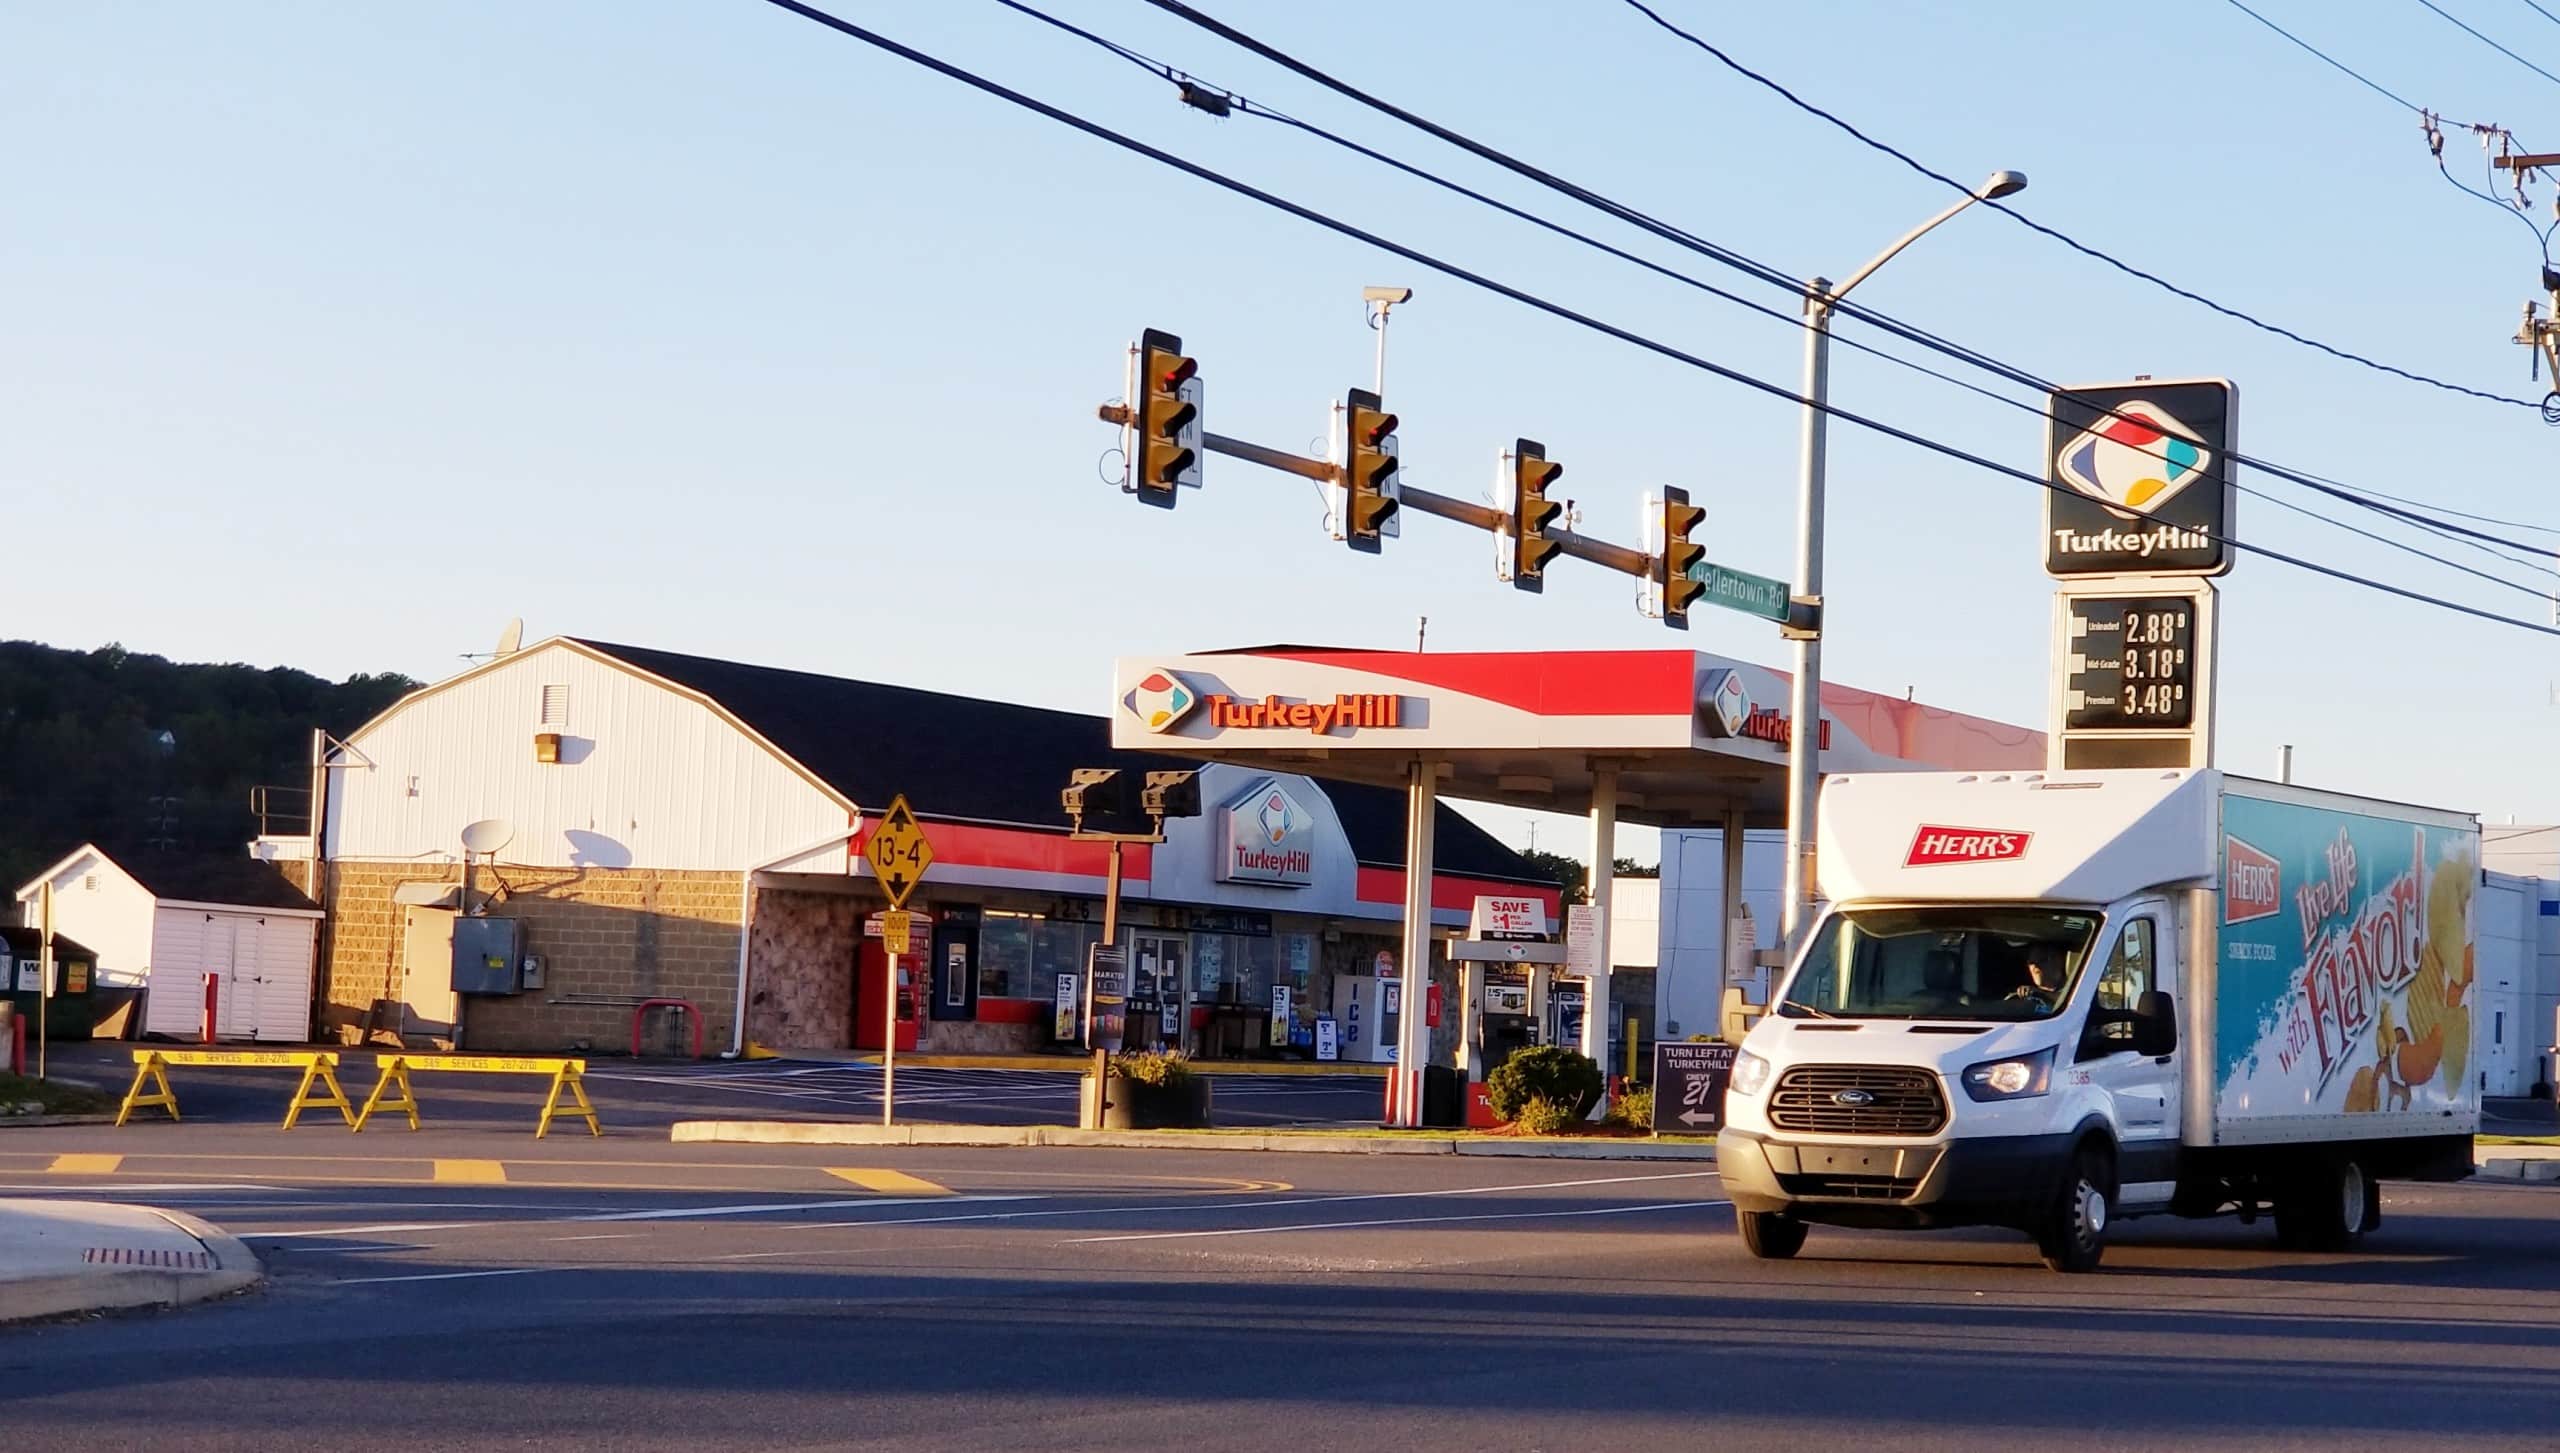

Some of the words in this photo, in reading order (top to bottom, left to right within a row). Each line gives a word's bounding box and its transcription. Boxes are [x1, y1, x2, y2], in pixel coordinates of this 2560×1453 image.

[1696, 566, 1764, 605] Hellertown
[1768, 585, 1784, 609] Rd
[2088, 621, 2120, 631] Unleaded
[2085, 696, 2116, 705] Premium
[1204, 694, 1401, 735] TurkeyHill
[1749, 703, 1831, 750] Turkell
[1920, 834, 2019, 857] HERR'S
[1236, 845, 1310, 877] TurkeyHill
[2231, 859, 2276, 905] HERR'S
[1491, 901, 1530, 913] SAVE
[1471, 998, 1478, 1010] 4
[2279, 1006, 2310, 1076] with
[206, 1054, 241, 1063] SERVICES
[1664, 1048, 1693, 1058] TURN
[1695, 1048, 1719, 1058] LEFT
[1720, 1049, 1735, 1058] AT
[451, 1058, 489, 1069] SERVICES
[1668, 1060, 1730, 1070] TURKEYHILL
[1686, 1073, 1711, 1081] CHEVY
